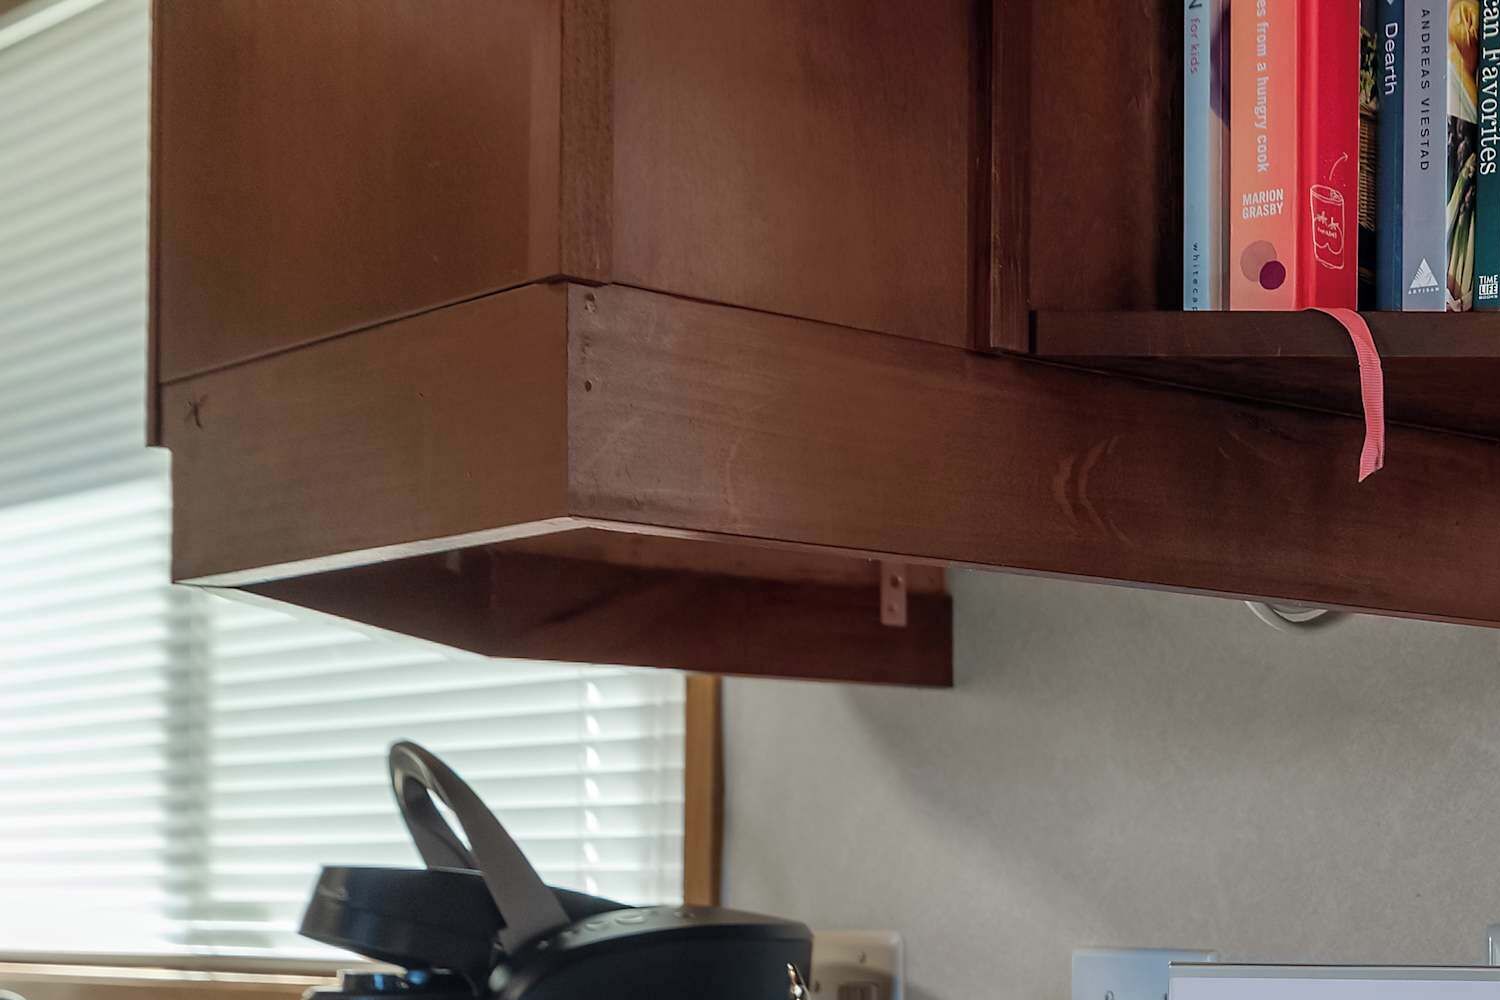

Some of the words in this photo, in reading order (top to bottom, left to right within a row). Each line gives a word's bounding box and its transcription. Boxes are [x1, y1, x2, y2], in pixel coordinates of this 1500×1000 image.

[1190, 18, 1201, 41] for
[1256, 22, 1270, 56] from
[1190, 43, 1200, 73] kids
[1384, 23, 1398, 95] Dearth
[1420, 8, 1431, 90] ANDREAS
[1257, 61, 1267, 71] a
[1254, 76, 1270, 130] hungry
[1420, 98, 1430, 171] VIESTAD
[1256, 135, 1270, 173] cook
[1242, 188, 1284, 206] MARION
[1242, 202, 1284, 220] GRASBY
[1478, 274, 1499, 285] TIME
